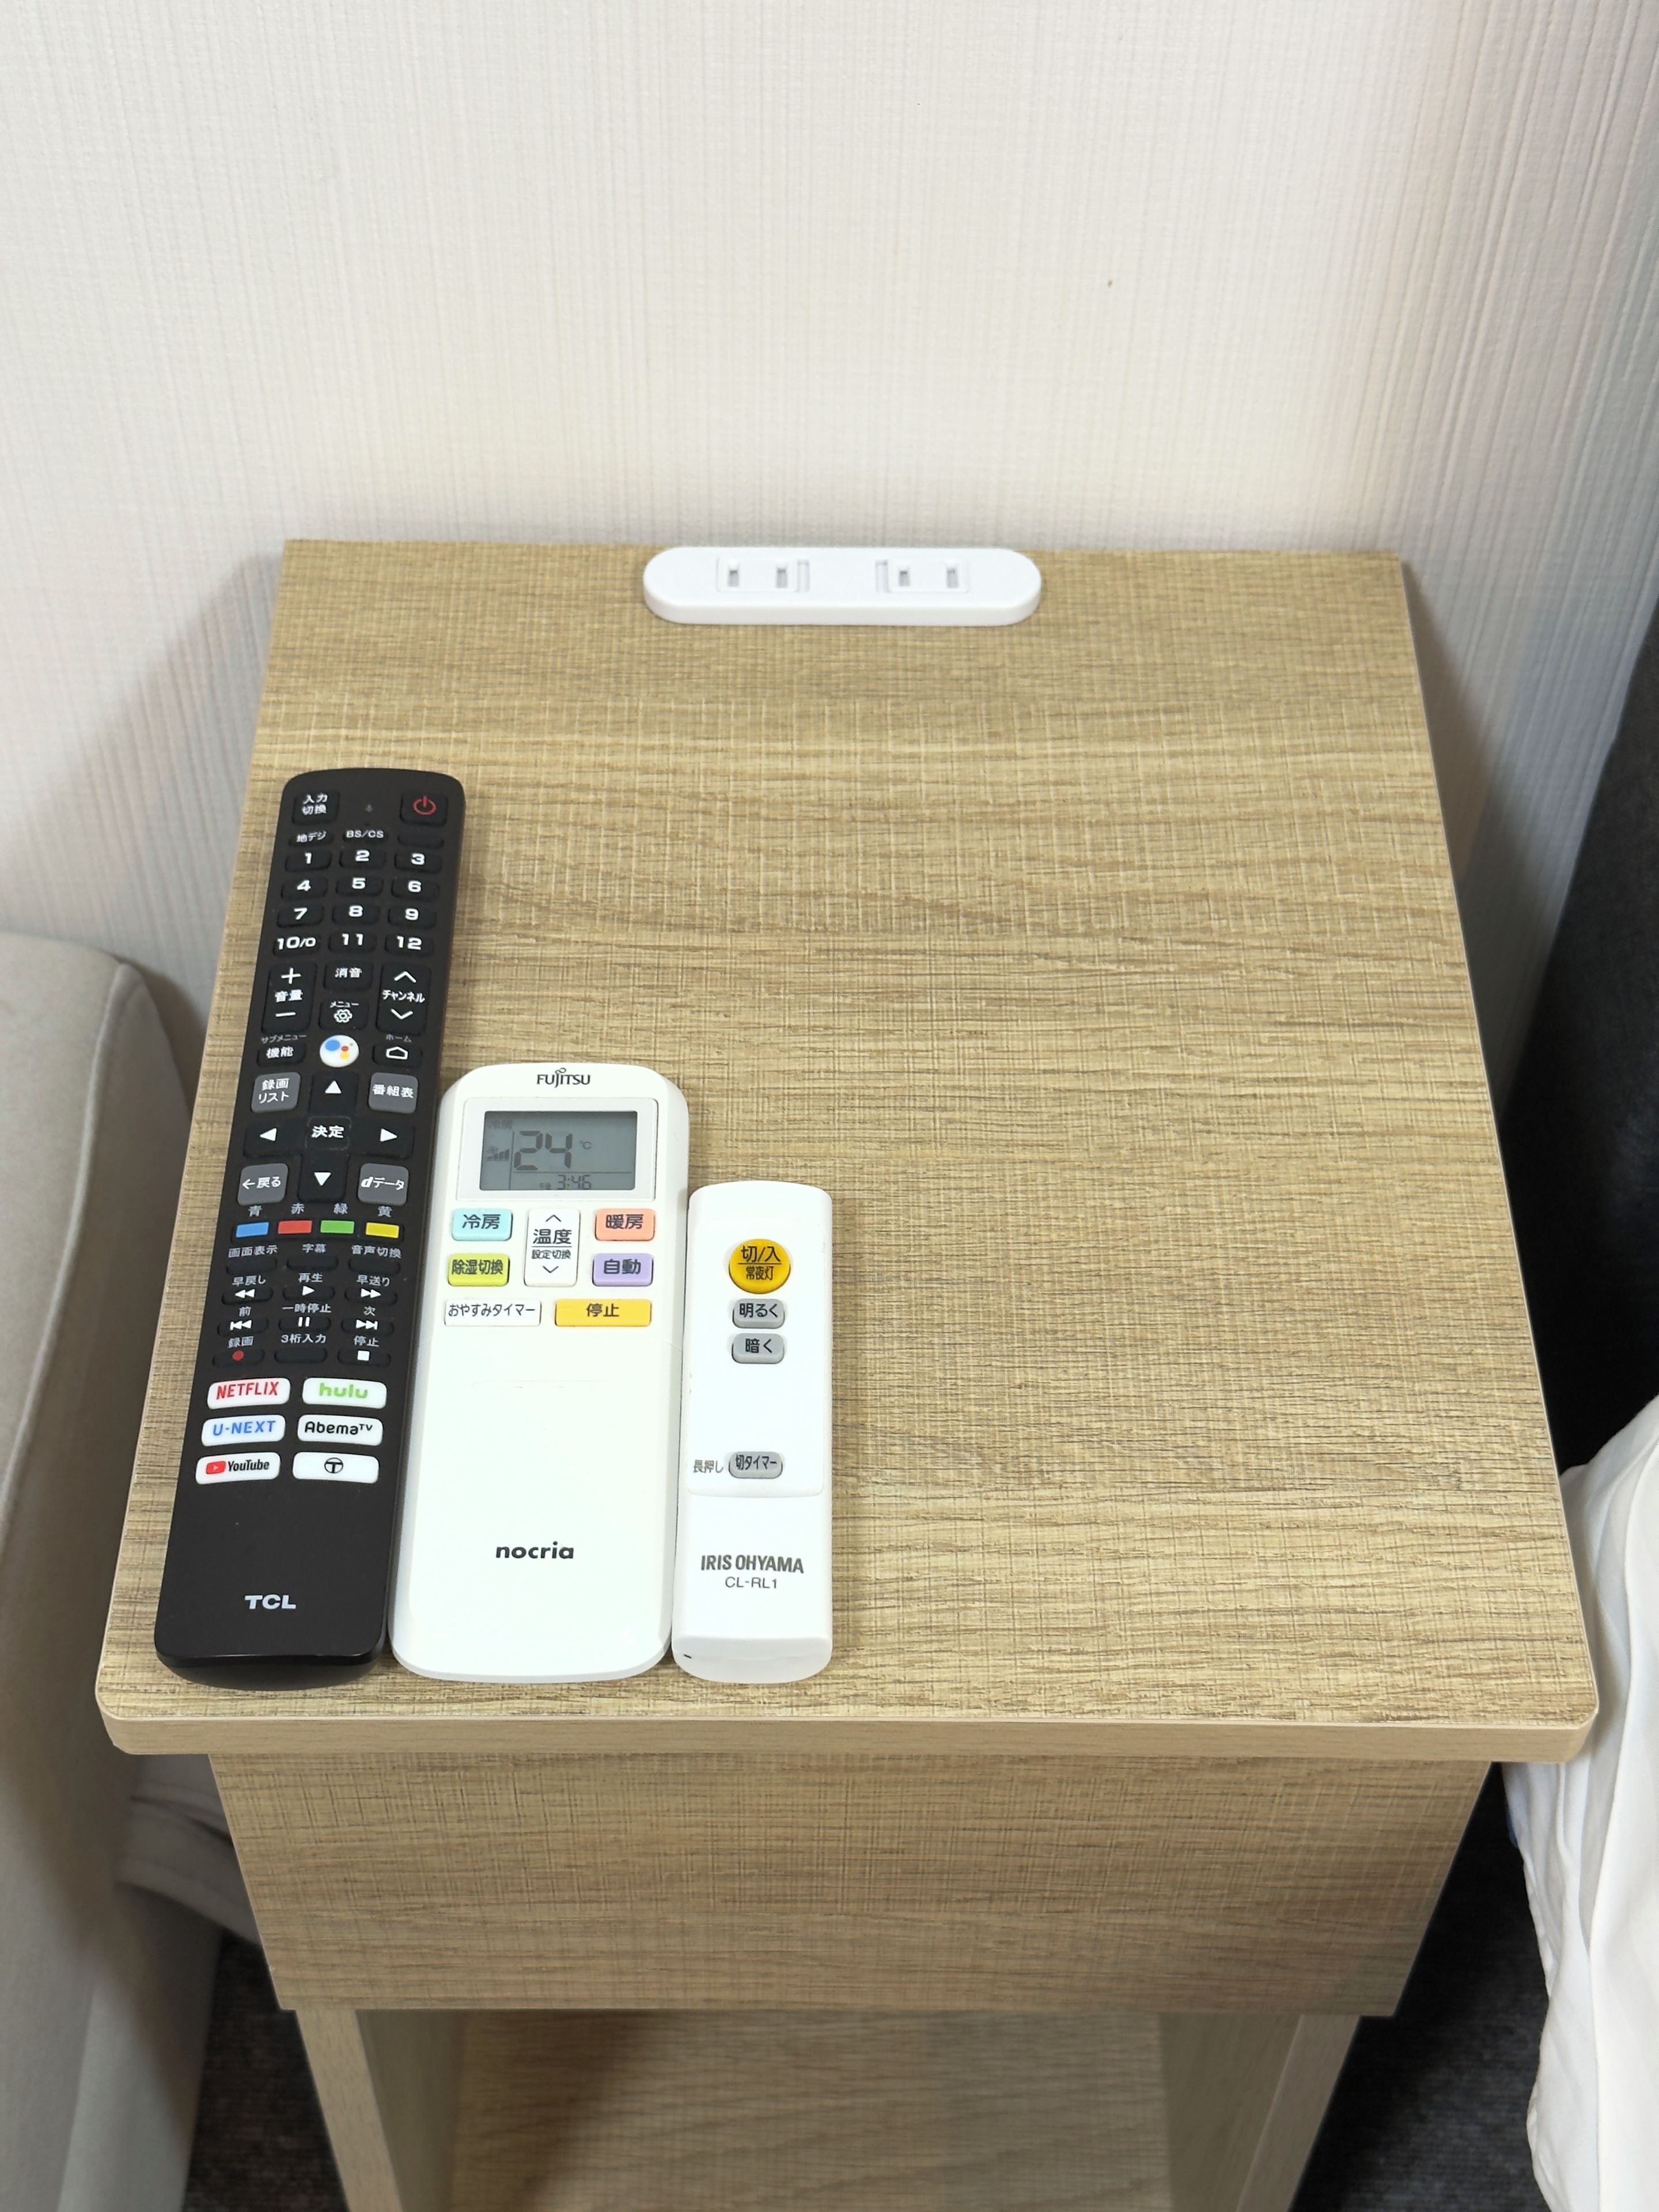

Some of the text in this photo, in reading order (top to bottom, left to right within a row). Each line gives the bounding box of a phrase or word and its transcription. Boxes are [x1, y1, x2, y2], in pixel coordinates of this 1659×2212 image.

[303, 794, 328, 804] 入力
[302, 805, 327, 815] 切換
[296, 831, 327, 843] 地デジ
[346, 830, 384, 839] BS/CS
[305, 853, 312, 864] 1
[355, 850, 370, 862] 2
[411, 853, 425, 865] 3
[297, 880, 311, 891] 4
[352, 877, 366, 889] 5
[408, 880, 422, 892] 6
[294, 907, 308, 920] 7
[349, 906, 363, 917] 8
[405, 908, 419, 921] 9
[342, 934, 363, 946] 11
[396, 936, 422, 950] 12
[335, 967, 362, 979] 消音
[275, 990, 303, 1002] 音量
[382, 990, 425, 1003] チャンネル
[261, 1035, 307, 1044] サブメニュー
[266, 1046, 294, 1058] 機能
[536, 1067, 591, 1088] FUJITSU
[262, 1078, 290, 1090] 録画
[372, 1084, 414, 1099] 番組表
[258, 1092, 289, 1104] リスト
[312, 1125, 344, 1138] 決定
[514, 1131, 573, 1171] 24
[558, 1174, 592, 1190] 3:46
[248, 1205, 262, 1217] 青
[291, 1203, 304, 1215] 赤
[334, 1203, 348, 1215] 緑
[378, 1206, 392, 1217] 黄
[462, 1214, 500, 1230] 冷房
[605, 1214, 644, 1230] 暖房
[533, 1228, 572, 1245] 温度
[228, 1245, 278, 1258] 画面表示
[302, 1243, 327, 1253] 字幕
[351, 1245, 402, 1259] 音声切換
[741, 1245, 781, 1263] 切/入
[532, 1249, 571, 1260] 設定切換
[451, 1259, 503, 1275] 除湿切換
[603, 1259, 642, 1275] 自動
[298, 1273, 323, 1283] 再生
[746, 1266, 774, 1281] 常夜灯
[232, 1275, 266, 1286] 早戻し
[356, 1274, 390, 1286] 早送り
[238, 1306, 252, 1317] 前
[282, 1303, 332, 1313] 一時停止
[363, 1306, 376, 1316] 次
[448, 1304, 536, 1317] おやすみタイマー
[586, 1302, 620, 1318] 停止
[739, 1303, 778, 1318] 明るく
[281, 1334, 327, 1344] 3桁入力
[354, 1336, 380, 1347] 停止
[745, 1338, 772, 1353] 暗く
[216, 1381, 279, 1400] NETFLIX
[319, 1382, 369, 1399] hulu
[213, 1421, 276, 1436] U-NEXT
[228, 1459, 270, 1472] YouTube
[694, 1454, 777, 1473] 長押し 切タイマー
[496, 1541, 574, 1559] nocria
[701, 1555, 804, 1574] IRIS OHYAMA
[725, 1576, 777, 1589] CL-RL1
[244, 1594, 296, 1609] TCL
